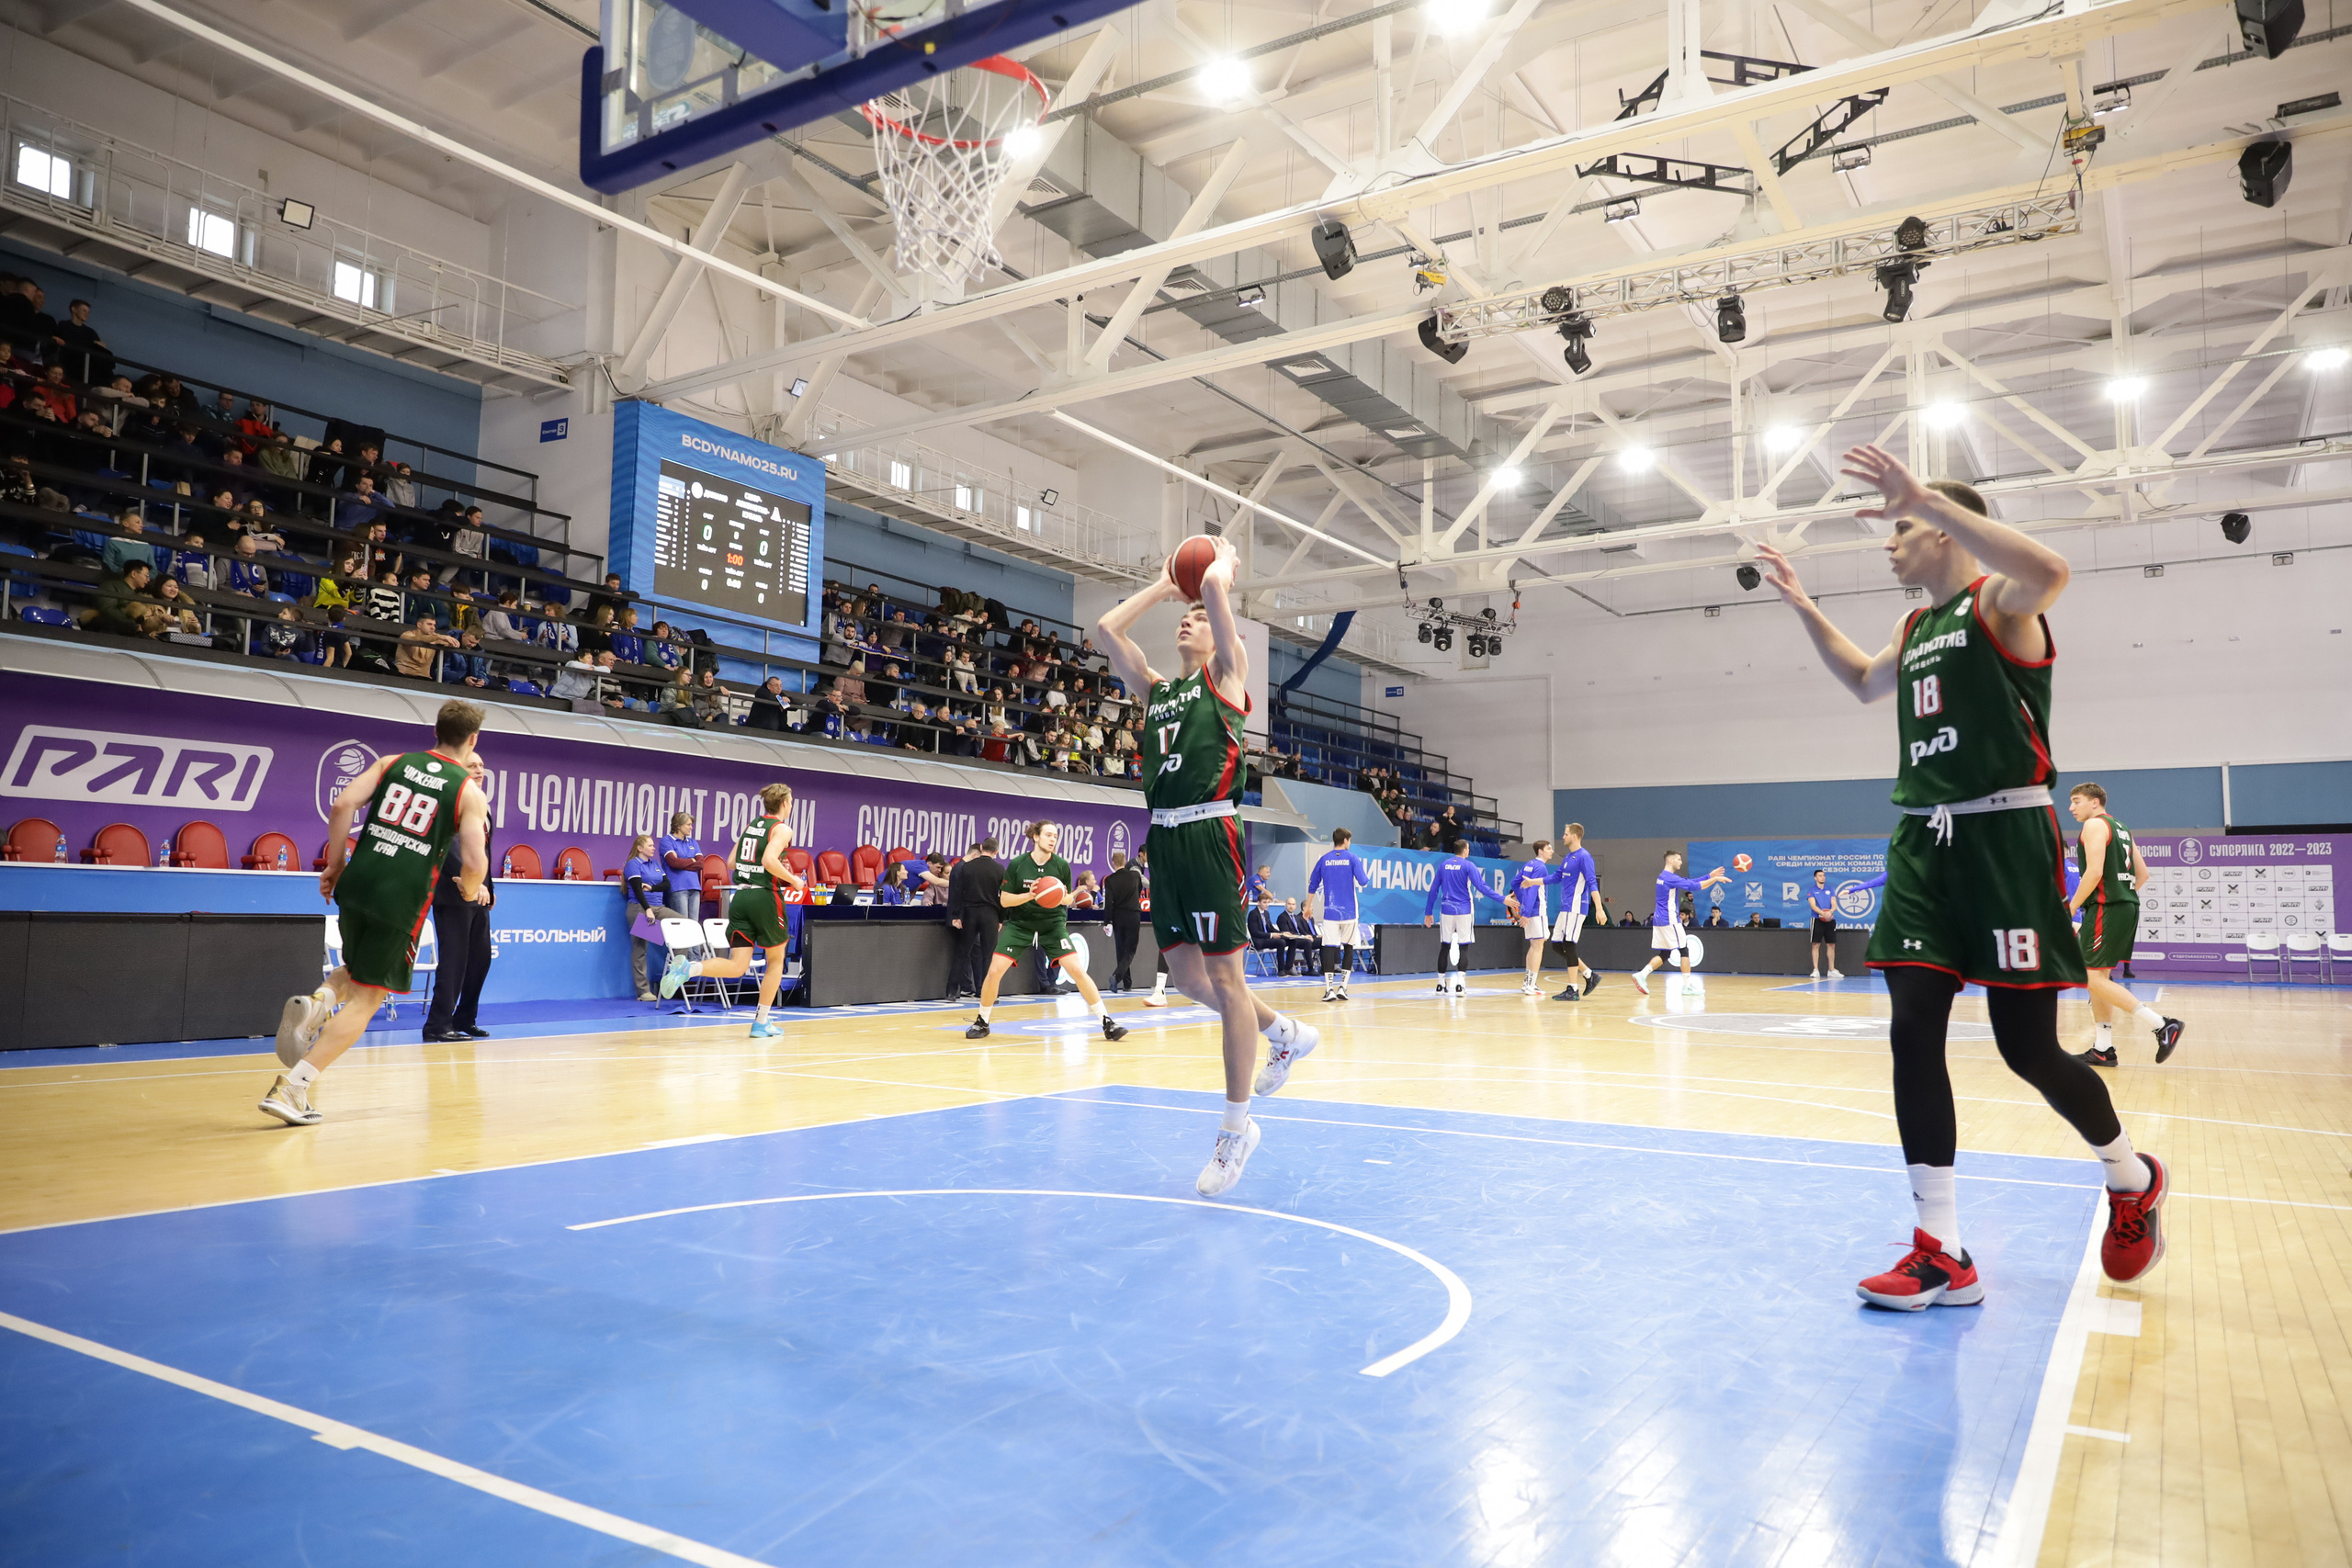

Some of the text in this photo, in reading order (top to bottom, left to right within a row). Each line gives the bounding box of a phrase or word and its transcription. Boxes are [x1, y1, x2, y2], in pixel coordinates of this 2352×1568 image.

[682, 434, 797, 481] BCDYNAMO25.RU
[703, 525, 712, 540] 0
[759, 540, 768, 556] 0
[727, 553, 743, 566] 1:00
[1903, 628, 1967, 667] ОКОМОТИВ
[1912, 674, 1943, 719] 18
[1158, 720, 1182, 755] 17
[9, 734, 264, 803] PARI
[403, 764, 448, 792] ЧИЖЕНОК
[378, 782, 439, 837] 88
[517, 772, 707, 840] ЧЕМПИОНАТ
[713, 790, 815, 848] РОСИИ
[367, 823, 432, 856] РАСНОДАРСКИЙ
[856, 805, 977, 858] СУПЕРЛИГА
[373, 840, 399, 857] КРАЙ
[740, 837, 758, 863] 81
[2209, 844, 2266, 857] СУПЕРЛИГА
[490, 926, 605, 942] КЕТБОЛЬНЫЙ
[1192, 911, 1219, 942] 17
[1060, 938, 1072, 950] 4
[1993, 929, 2041, 972] 18
